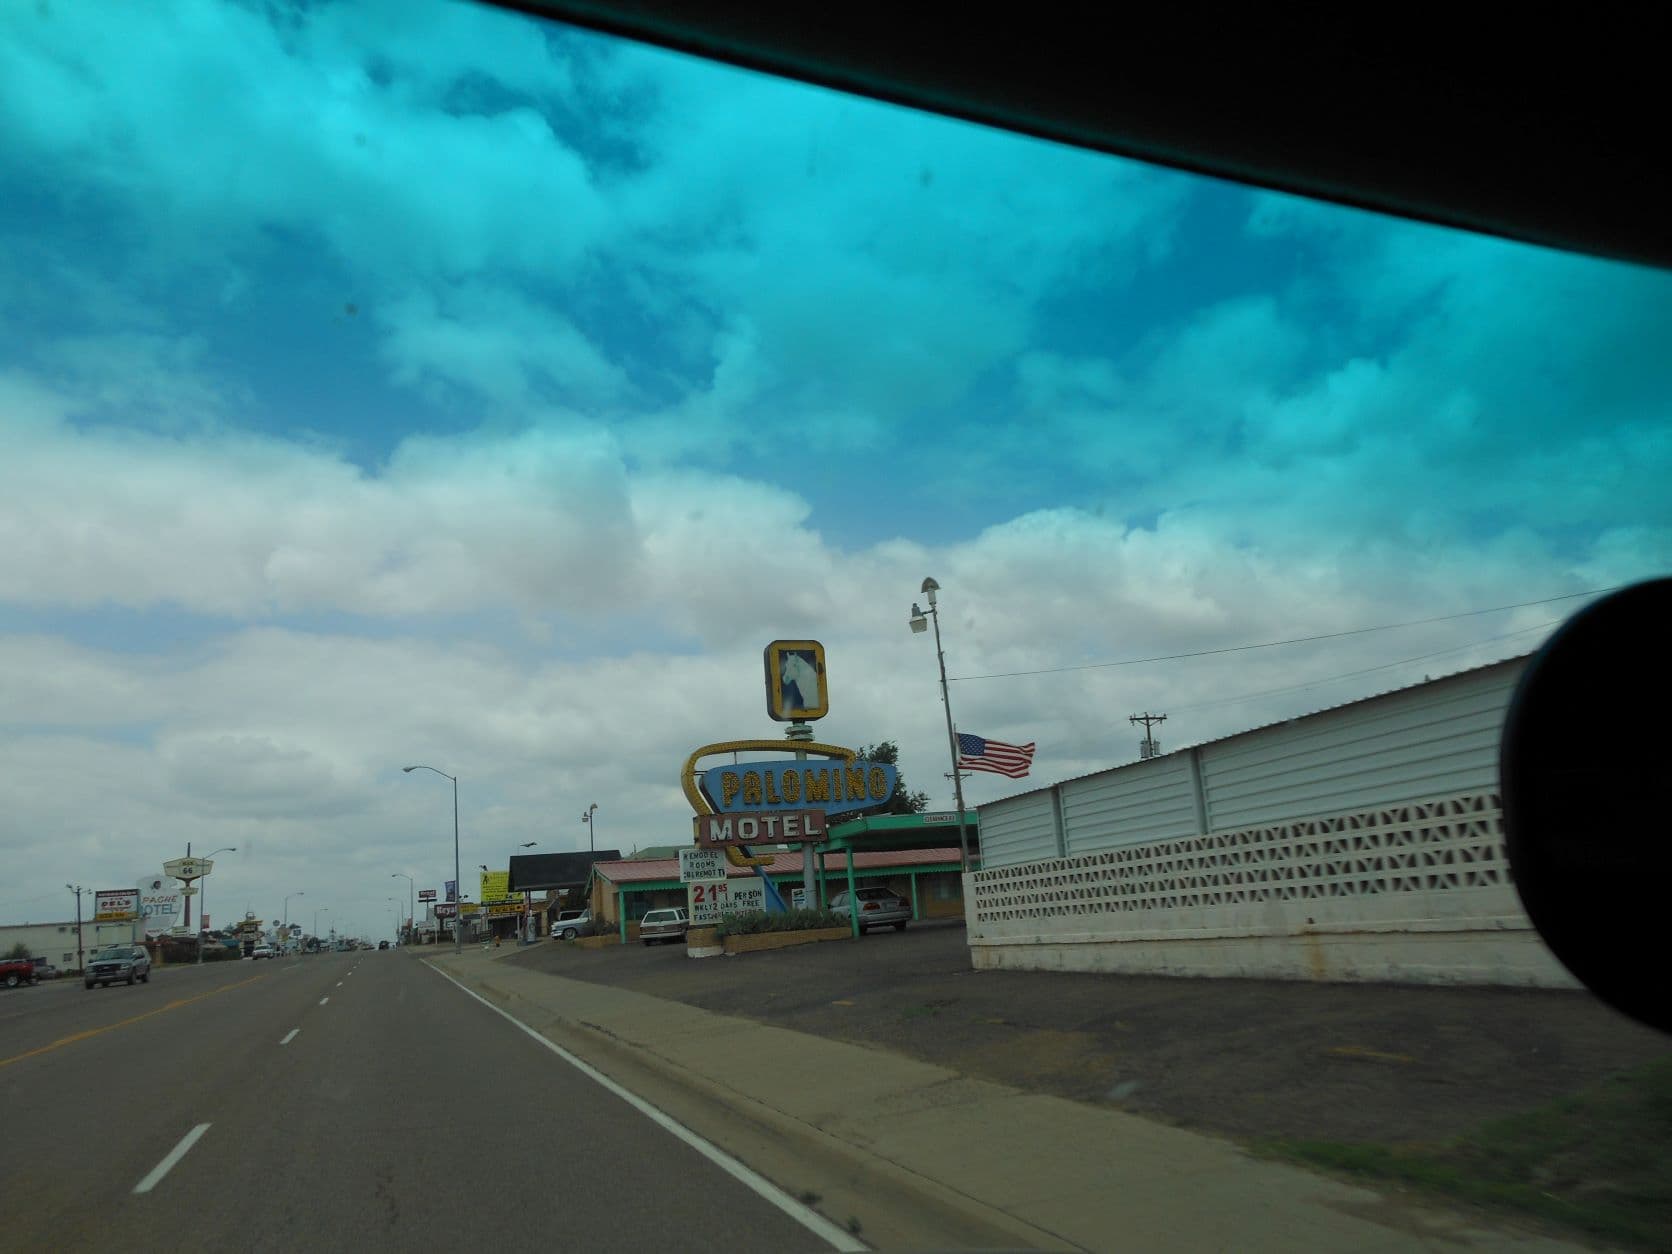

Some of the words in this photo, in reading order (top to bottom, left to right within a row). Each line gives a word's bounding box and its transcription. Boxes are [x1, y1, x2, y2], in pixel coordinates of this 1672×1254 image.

[721, 767, 888, 808] PALOMINO
[710, 814, 822, 841] MOTEL
[689, 861, 716, 869] ROOMS
[142, 896, 178, 904] PACHE
[734, 890, 762, 901] PERSON
